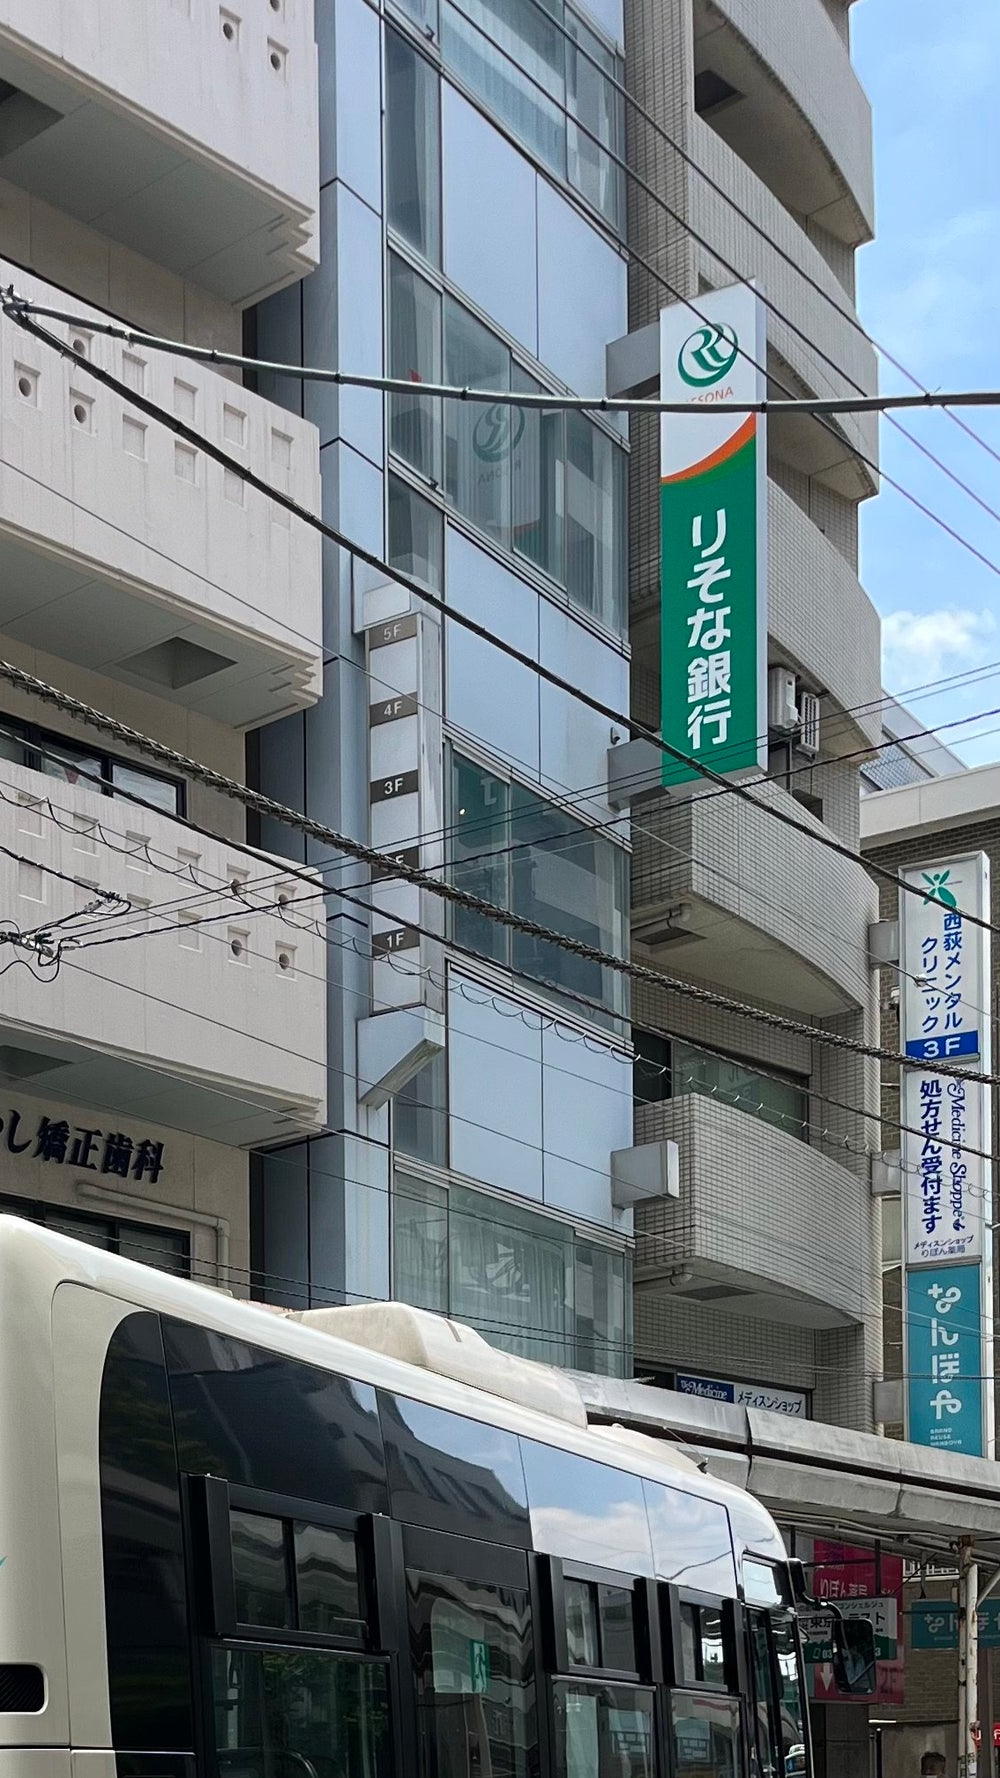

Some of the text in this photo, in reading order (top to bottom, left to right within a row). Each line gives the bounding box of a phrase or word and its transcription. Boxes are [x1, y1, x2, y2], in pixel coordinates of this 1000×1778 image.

[383, 624, 402, 640] 5F
[687, 508, 732, 750] りそな銀行
[384, 700, 402, 717] 4F
[384, 778, 404, 795] 3F
[386, 932, 405, 949] 1F
[943, 911, 963, 1029] 西荻メンタル
[921, 937, 940, 1033] クリニック
[923, 1036, 961, 1058] 3F
[920, 1079, 942, 1234] 処方せん受付ます
[928, 1283, 962, 1420] なんぼや
